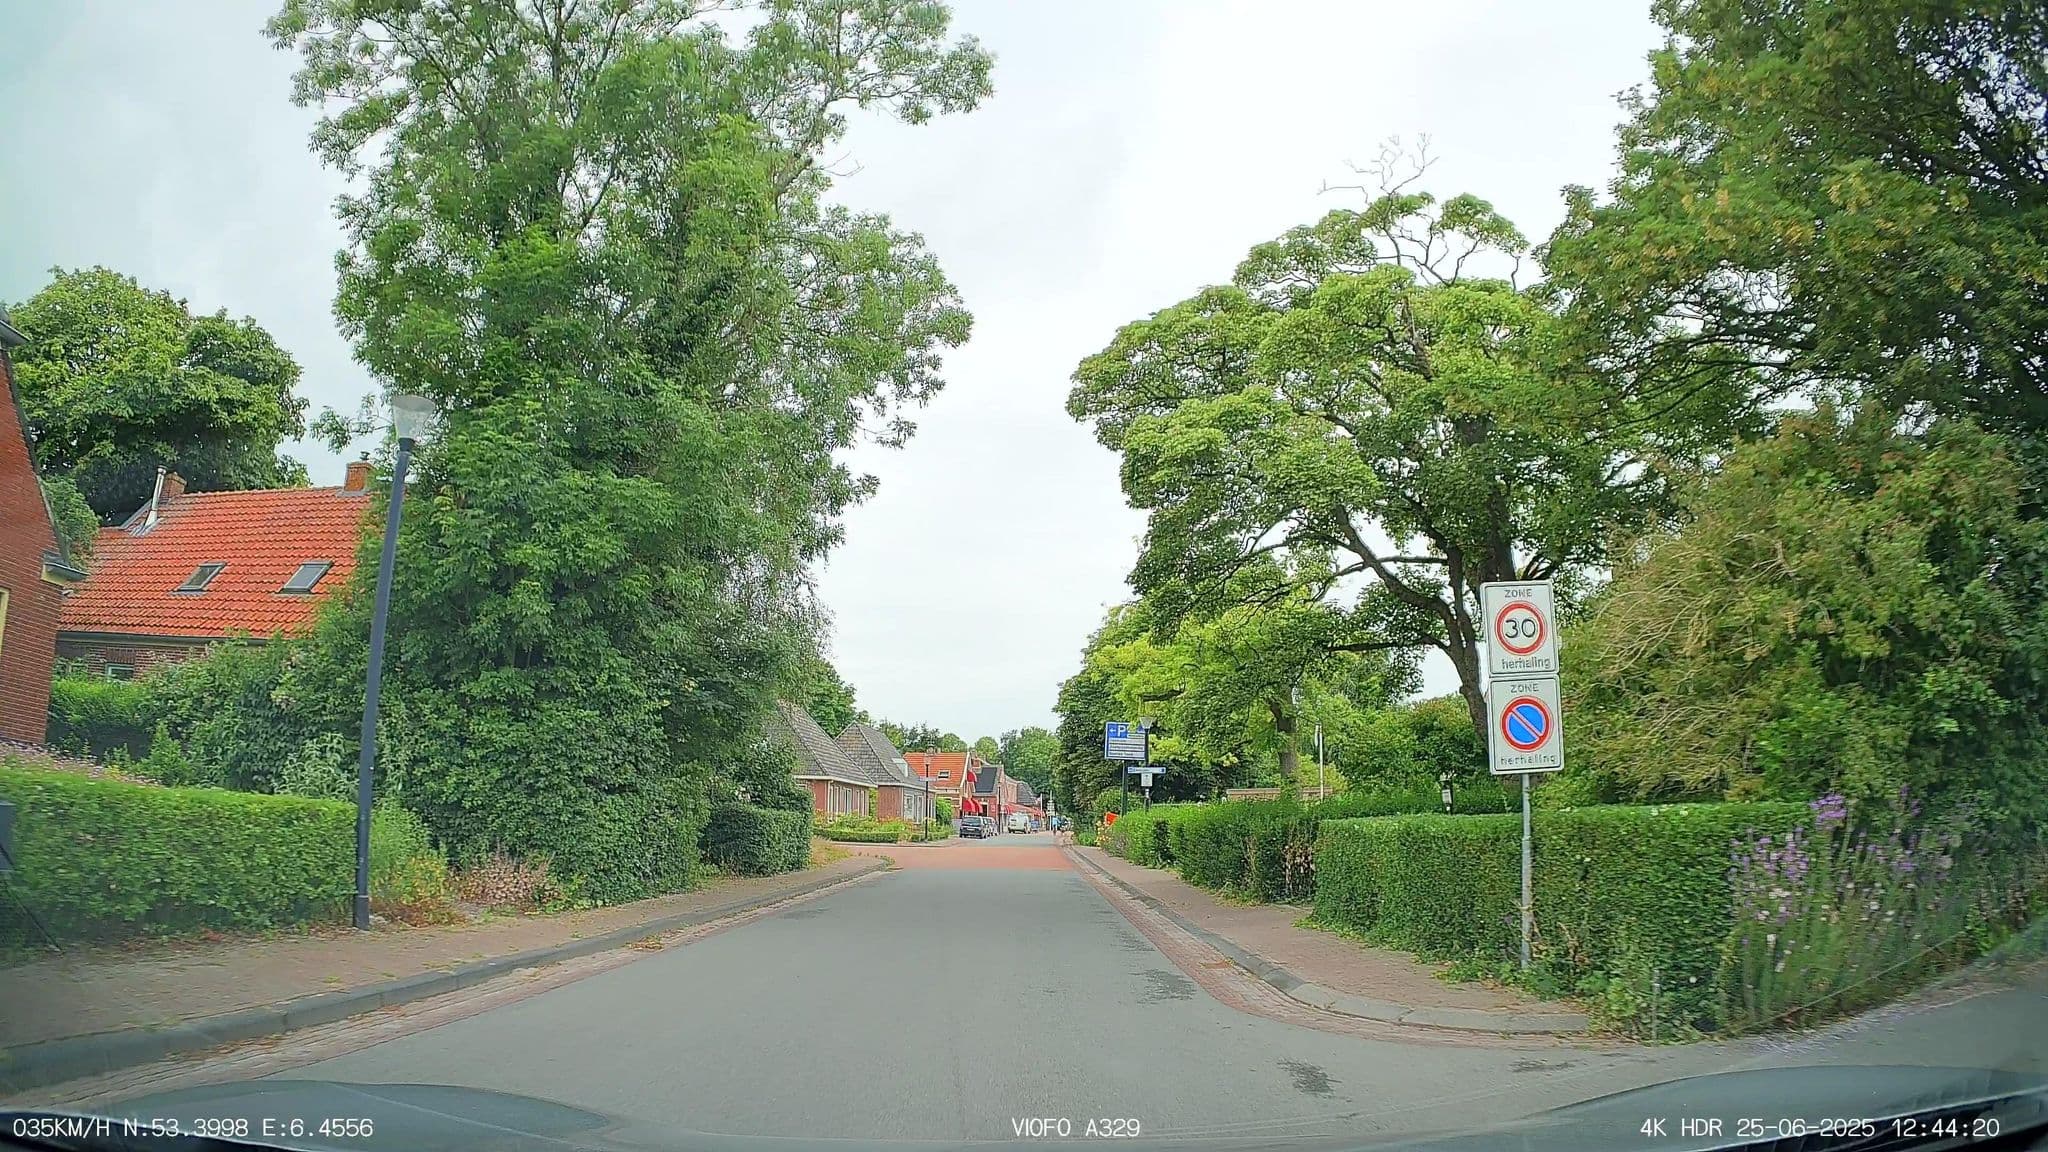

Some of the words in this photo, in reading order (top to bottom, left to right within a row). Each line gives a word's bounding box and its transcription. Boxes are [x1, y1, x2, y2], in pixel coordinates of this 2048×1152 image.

[1504, 588, 1533, 598] ZONE
[1505, 618, 1536, 638] 30
[1501, 656, 1552, 669] herhaling
[1510, 683, 1539, 693] ZONE
[1117, 725, 1126, 737] P
[1500, 753, 1556, 765] herhaling
